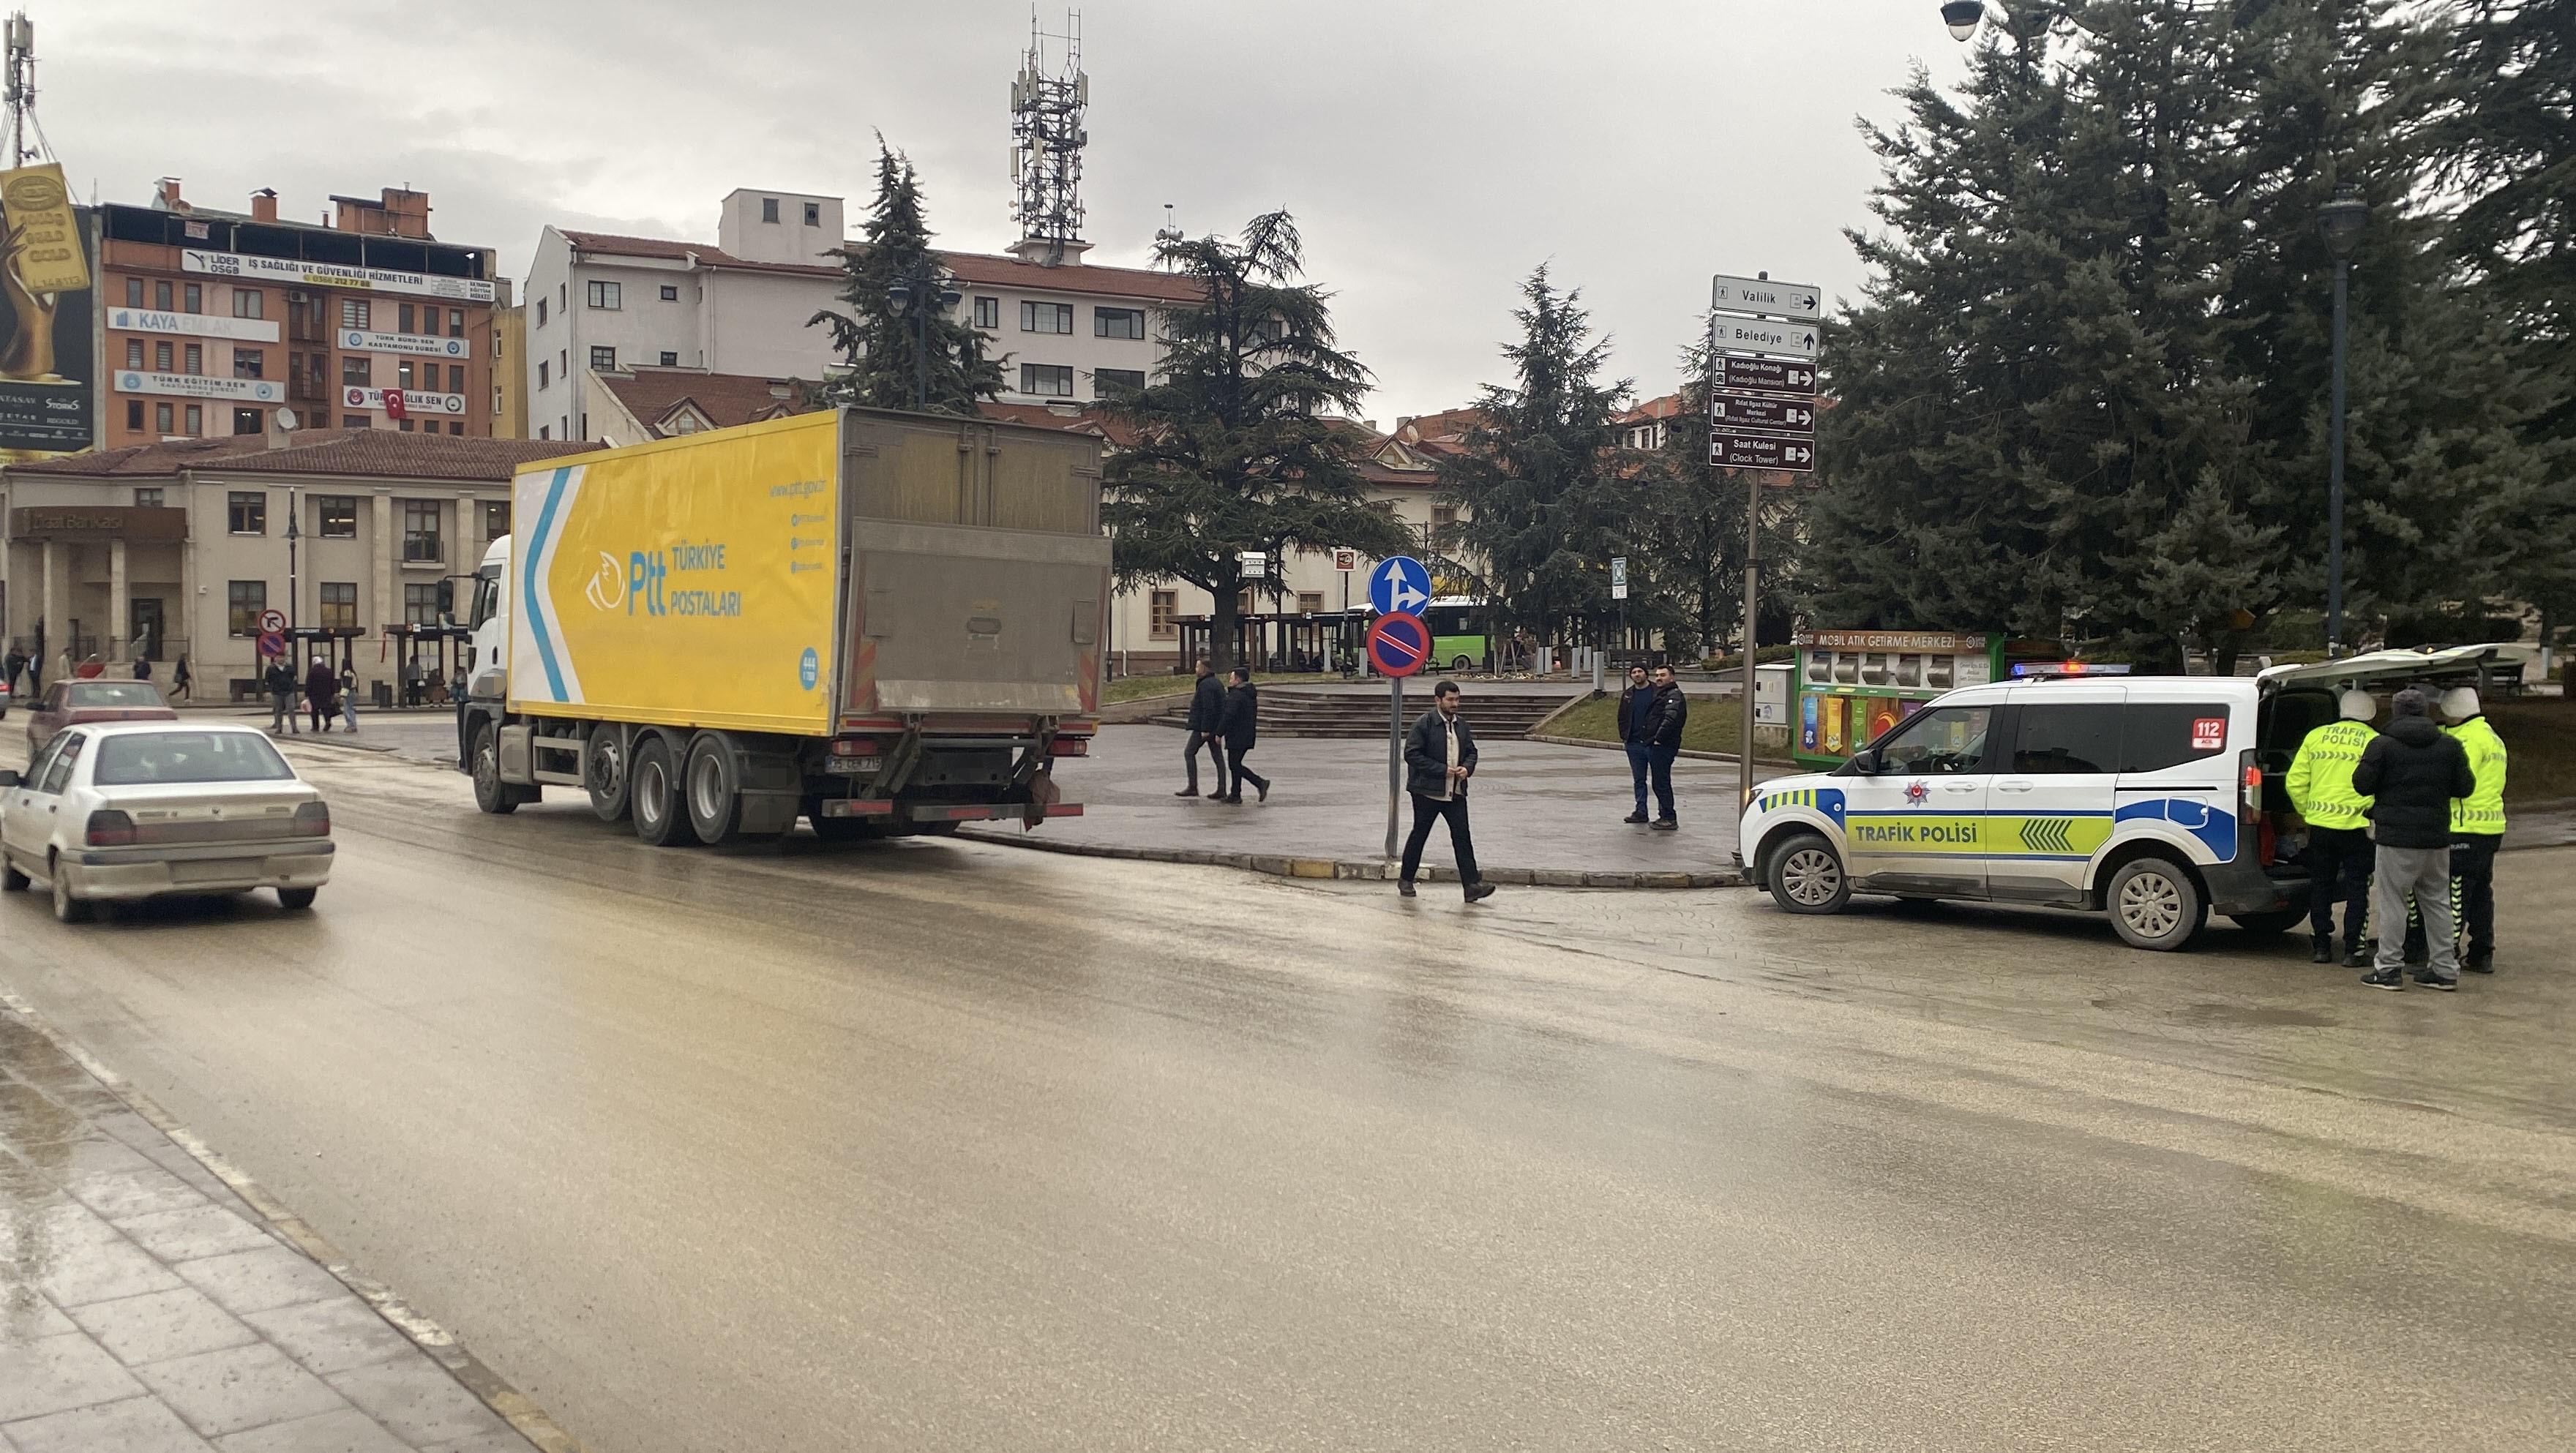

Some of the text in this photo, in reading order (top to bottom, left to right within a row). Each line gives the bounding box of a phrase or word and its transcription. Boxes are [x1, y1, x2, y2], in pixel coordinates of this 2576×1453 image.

[211, 254, 239, 266] LİDER
[211, 264, 239, 274] OSGB
[249, 257, 423, 285] İŞ SAĞLIĞI VE GÜVENLİĞİ HİZMETLERİ
[334, 277, 348, 285] 212
[1742, 289, 1775, 304] Valilik
[139, 312, 179, 330] KAYA
[1735, 328, 1782, 345] Belediye
[368, 342, 413, 350] KASTAMONU
[1731, 361, 1782, 373] Kadıoğlu Konağı
[152, 375, 181, 384] TÜRK
[368, 390, 441, 405] TÜR ĞLIK SEN
[1733, 439, 1776, 451] Saat Kulesi
[1729, 453, 1779, 466] (Clock Tower)
[628, 538, 726, 616] Ptt TÜRKİYE
[670, 590, 741, 616] POSTALARI
[1819, 633, 1955, 648] MOBİL ATIK GETİRME MERKEZİ
[2198, 721, 2220, 737] 112
[1856, 822, 1977, 843] TRAFİK POLİSİ
